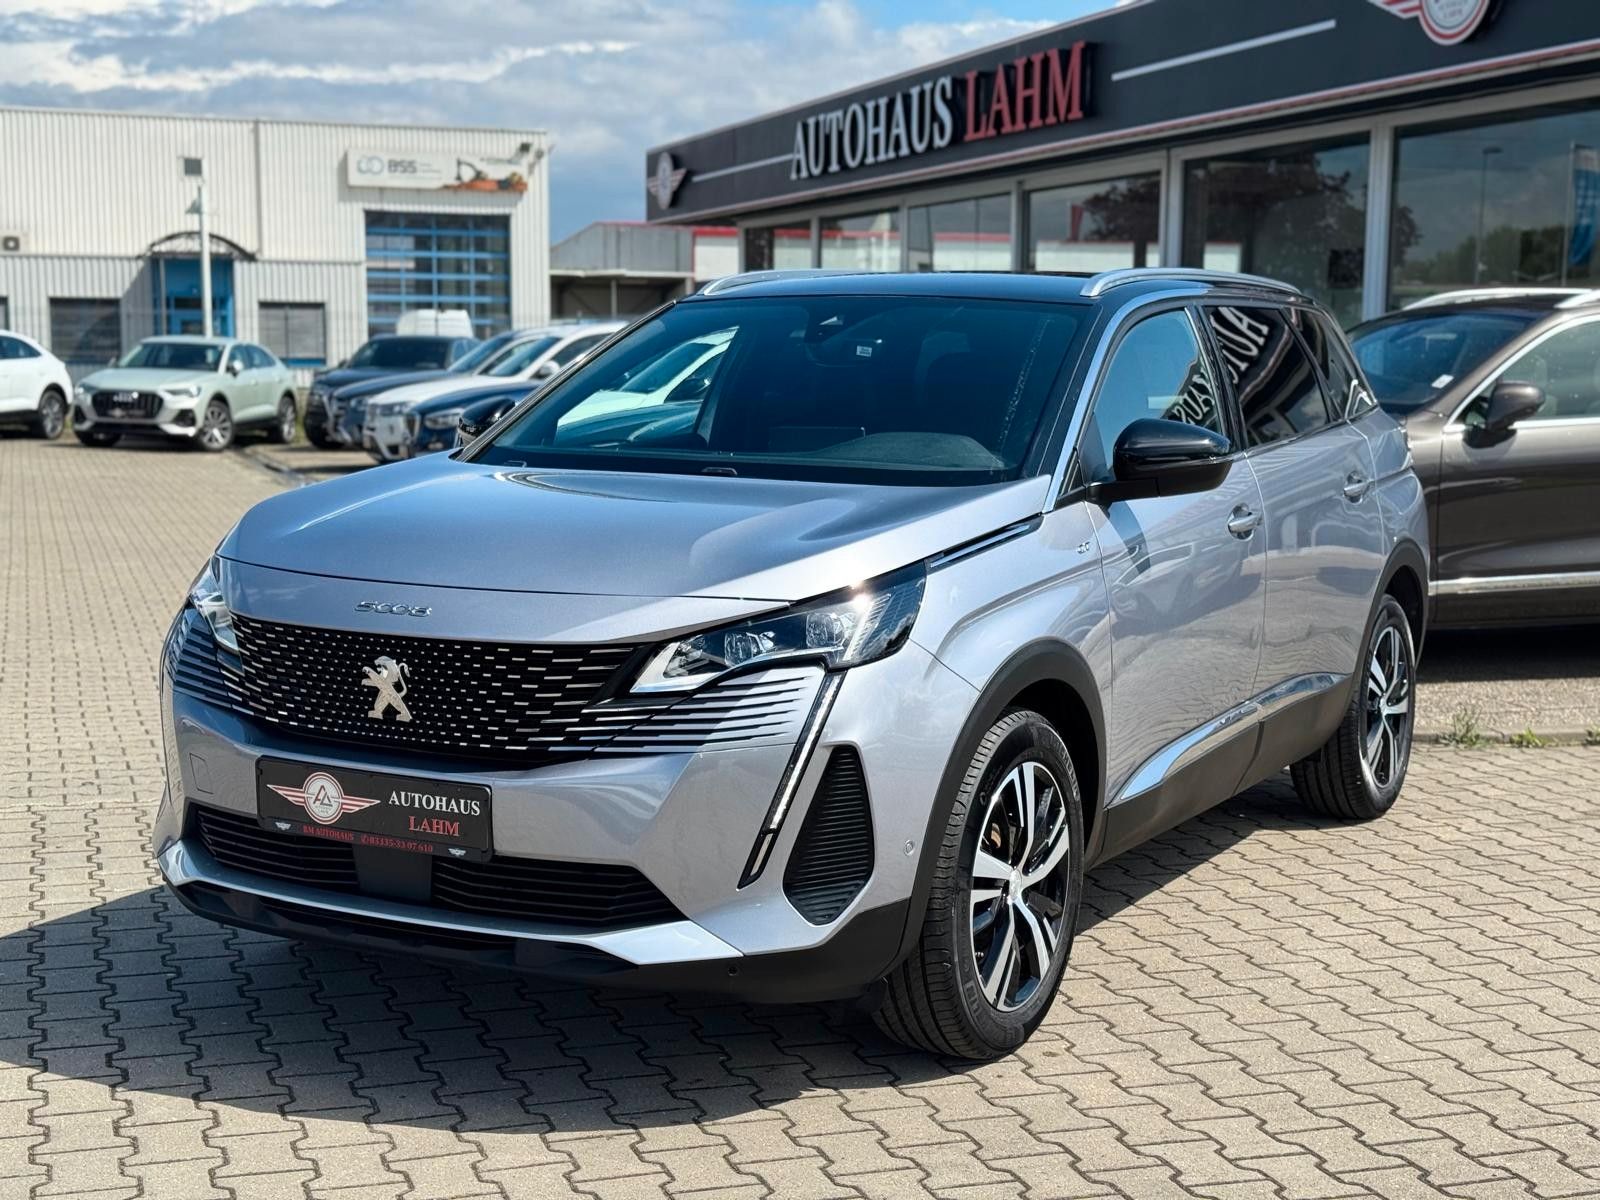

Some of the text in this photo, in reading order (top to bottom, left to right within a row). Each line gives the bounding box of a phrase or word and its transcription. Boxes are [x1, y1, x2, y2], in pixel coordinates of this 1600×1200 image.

[790, 40, 1087, 181] AUTOHAUS LAHM
[388, 790, 481, 816] AUTOHAUS
[315, 828, 355, 841] AUTOHAUS
[408, 815, 461, 837] LAHM
